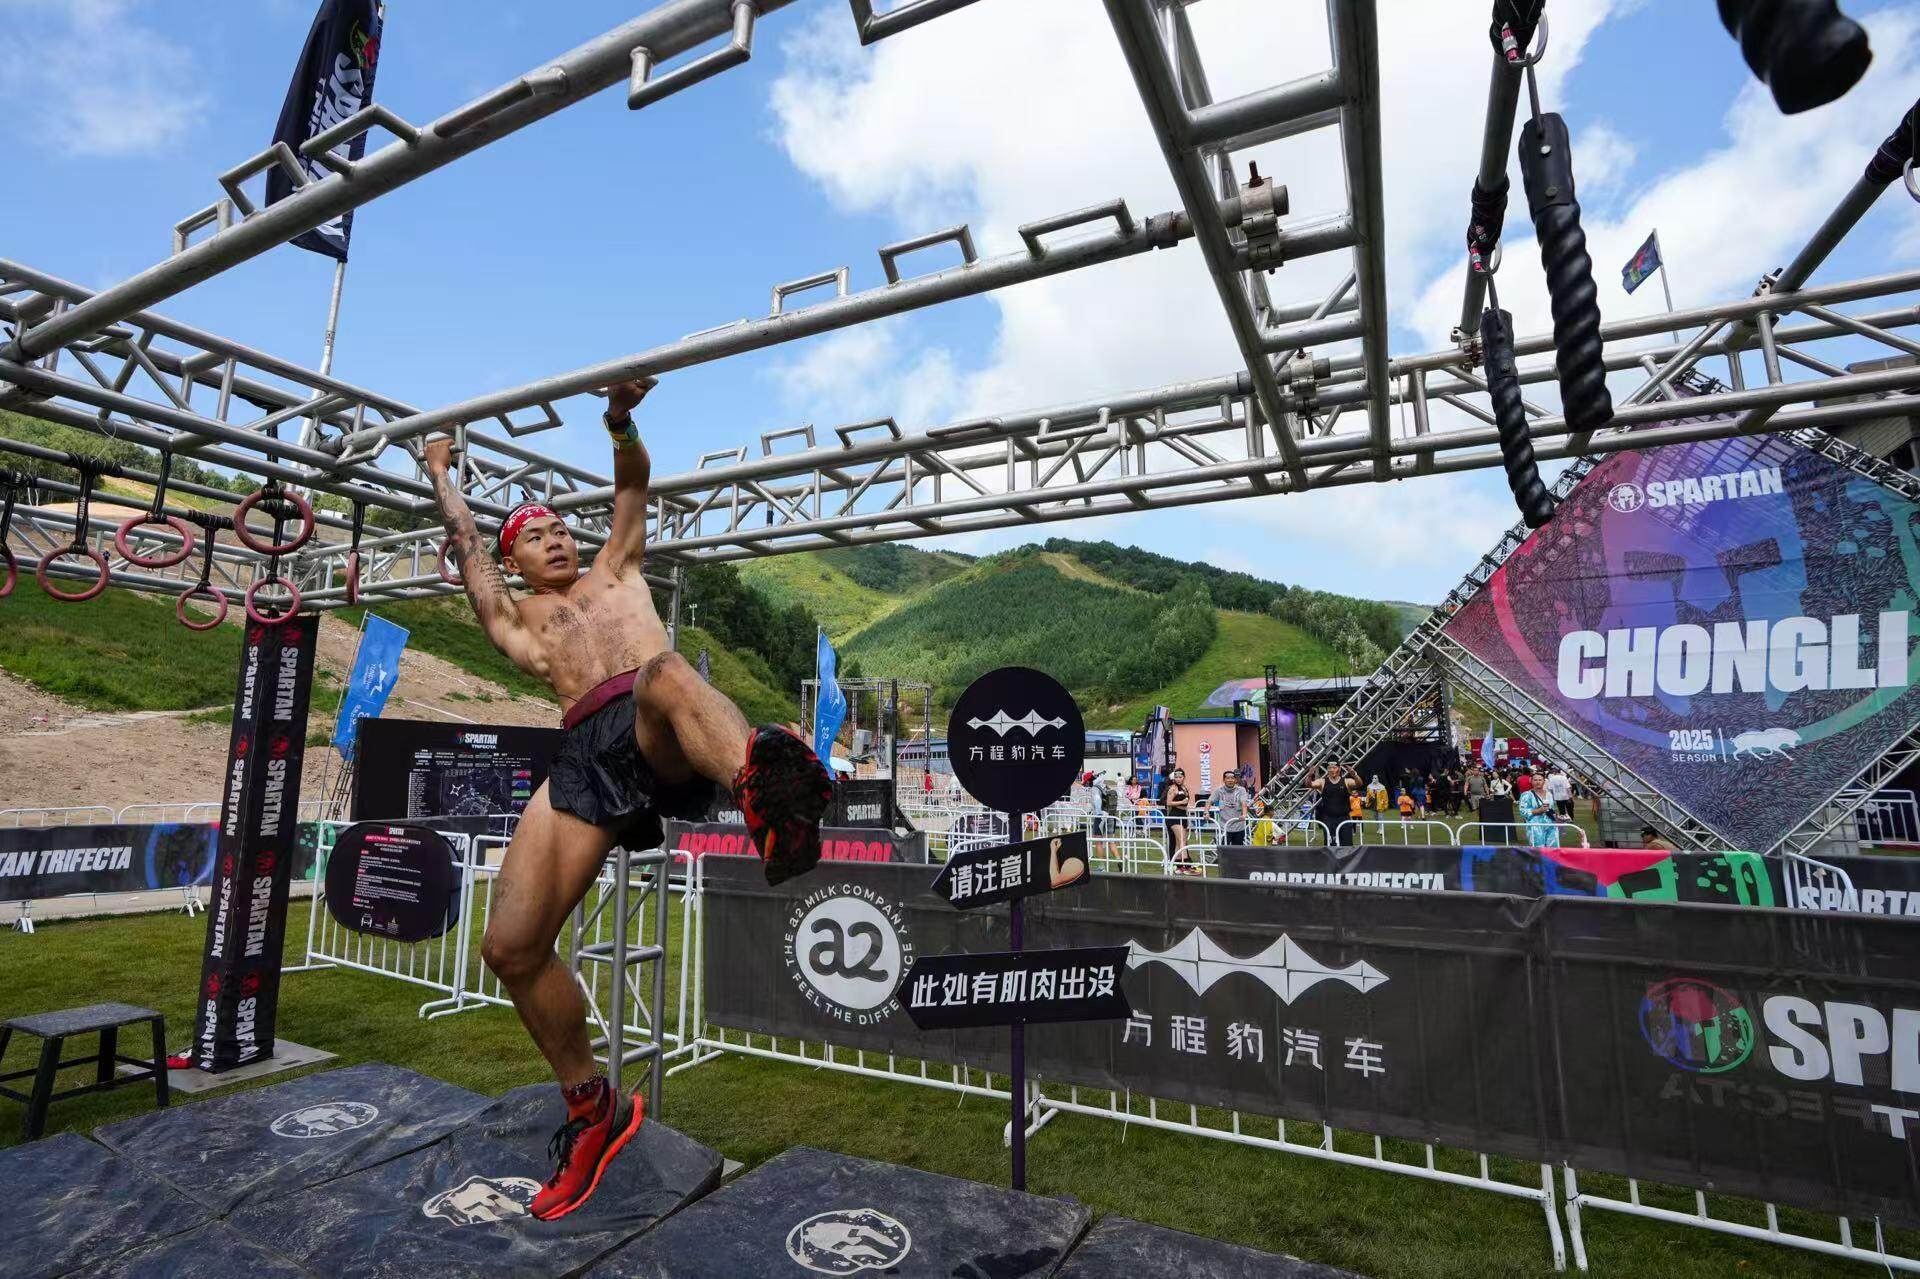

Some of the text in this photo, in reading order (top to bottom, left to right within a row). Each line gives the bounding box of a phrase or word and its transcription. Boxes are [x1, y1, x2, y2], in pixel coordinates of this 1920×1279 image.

[1646, 467, 1784, 508] SPARTAN
[242, 646, 258, 719] SPARTAN
[274, 647, 298, 720] SPARTAN
[1557, 611, 1909, 699] CHONGLI
[464, 733, 498, 744] SPARTAN
[969, 745, 1066, 761] 方程豹汽车
[1669, 729, 1714, 751] 2025
[1671, 752, 1717, 763] SEASON
[226, 759, 245, 836] SPARTAN
[260, 759, 286, 837] SPARTAN
[847, 804, 881, 821] SPARTAN
[37, 846, 132, 875] TRIFECTA
[211, 877, 232, 959] SPARTAN
[244, 876, 272, 957] SPARTAN
[784, 883, 909, 967] THE a2 MILK COMPANY
[809, 918, 889, 983] a2
[792, 974, 822, 1008] FEEL
[825, 1003, 852, 1023] THE
[911, 965, 1115, 1008] 此处有肌肉出没
[1122, 1009, 1385, 1077] 方程豹汽车
